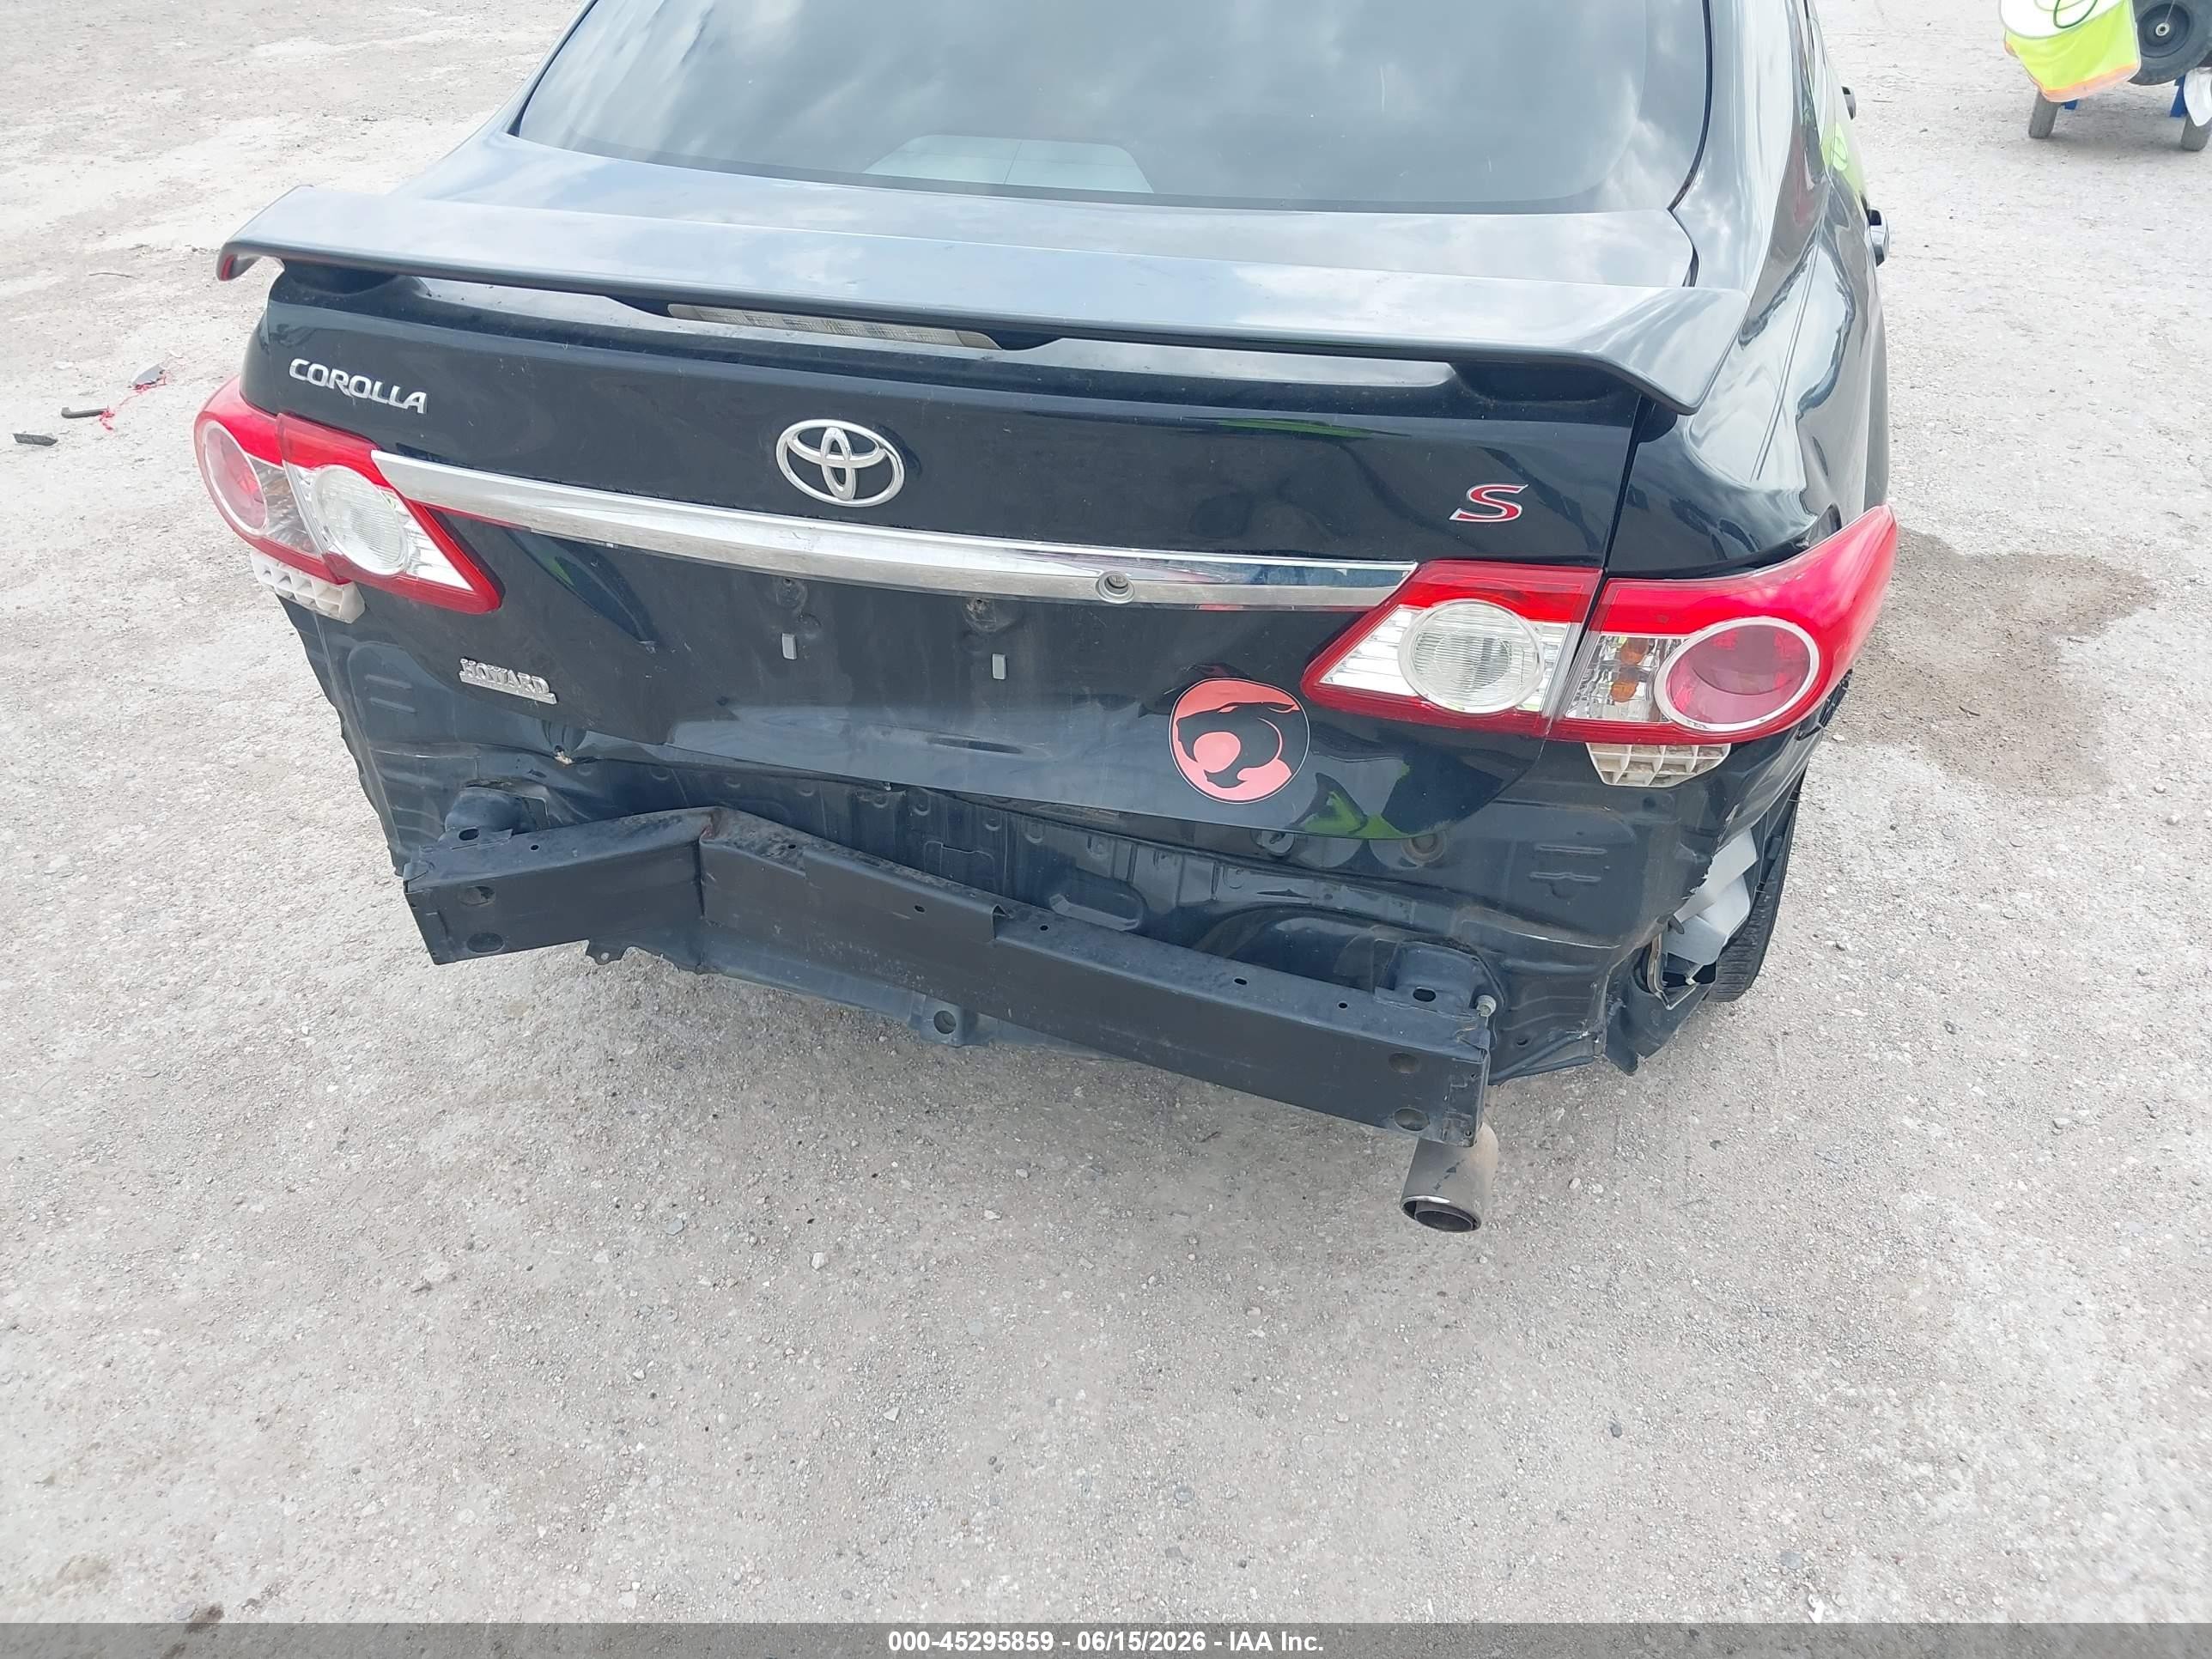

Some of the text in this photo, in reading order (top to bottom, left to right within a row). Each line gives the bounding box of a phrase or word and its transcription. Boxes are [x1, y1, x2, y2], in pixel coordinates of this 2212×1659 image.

[289, 358, 428, 414] COROLLA
[1449, 483, 1528, 523] S
[459, 658, 550, 695] HOWARD
